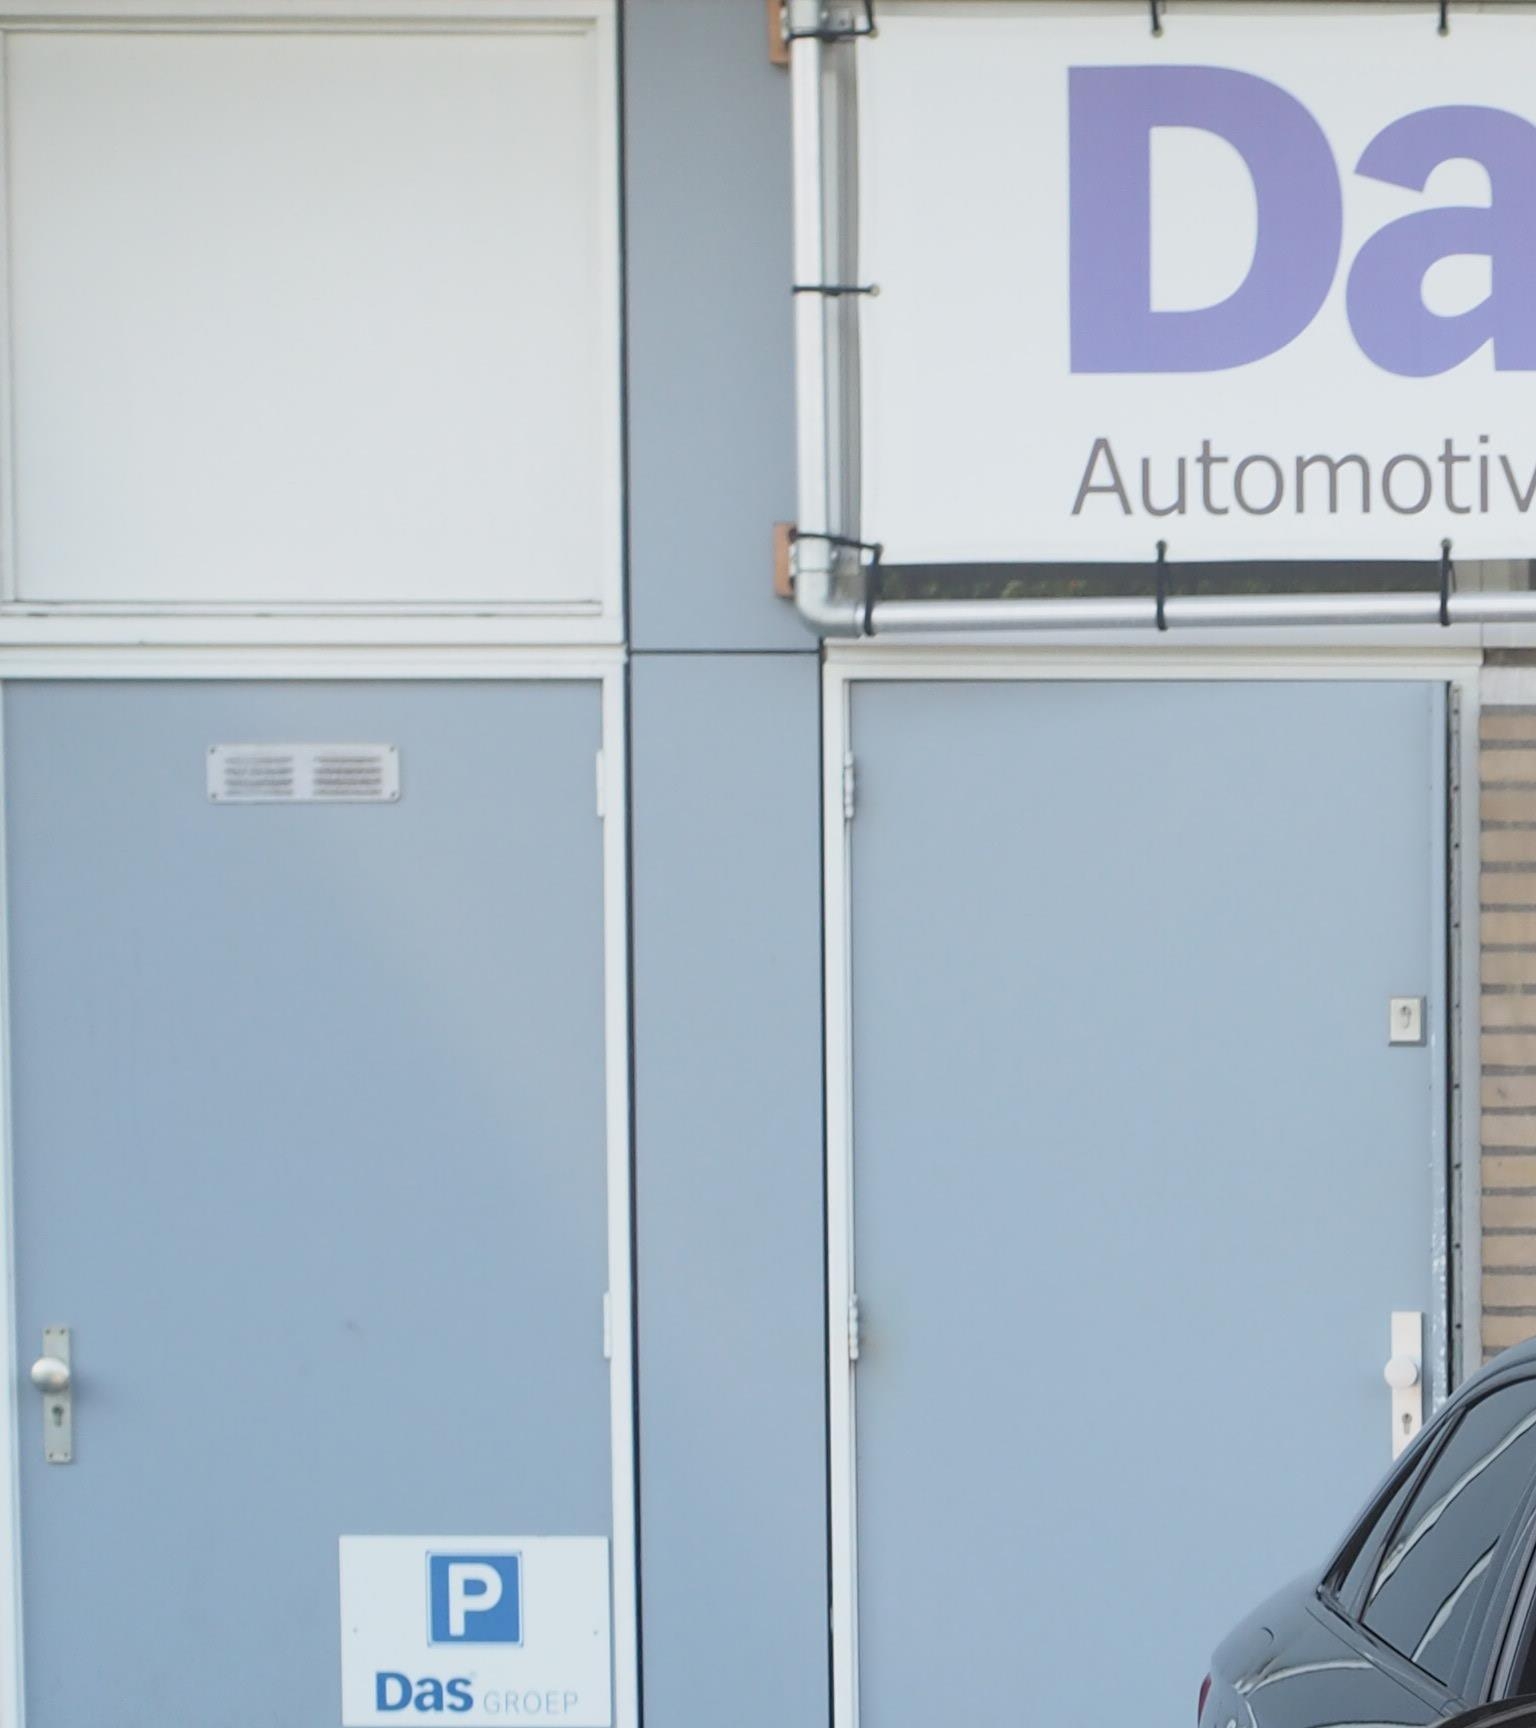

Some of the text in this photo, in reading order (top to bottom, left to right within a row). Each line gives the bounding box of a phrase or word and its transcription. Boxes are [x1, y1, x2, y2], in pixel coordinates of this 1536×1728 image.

[448, 1562, 503, 1637] P
[375, 1671, 579, 1716] Das GROEP
